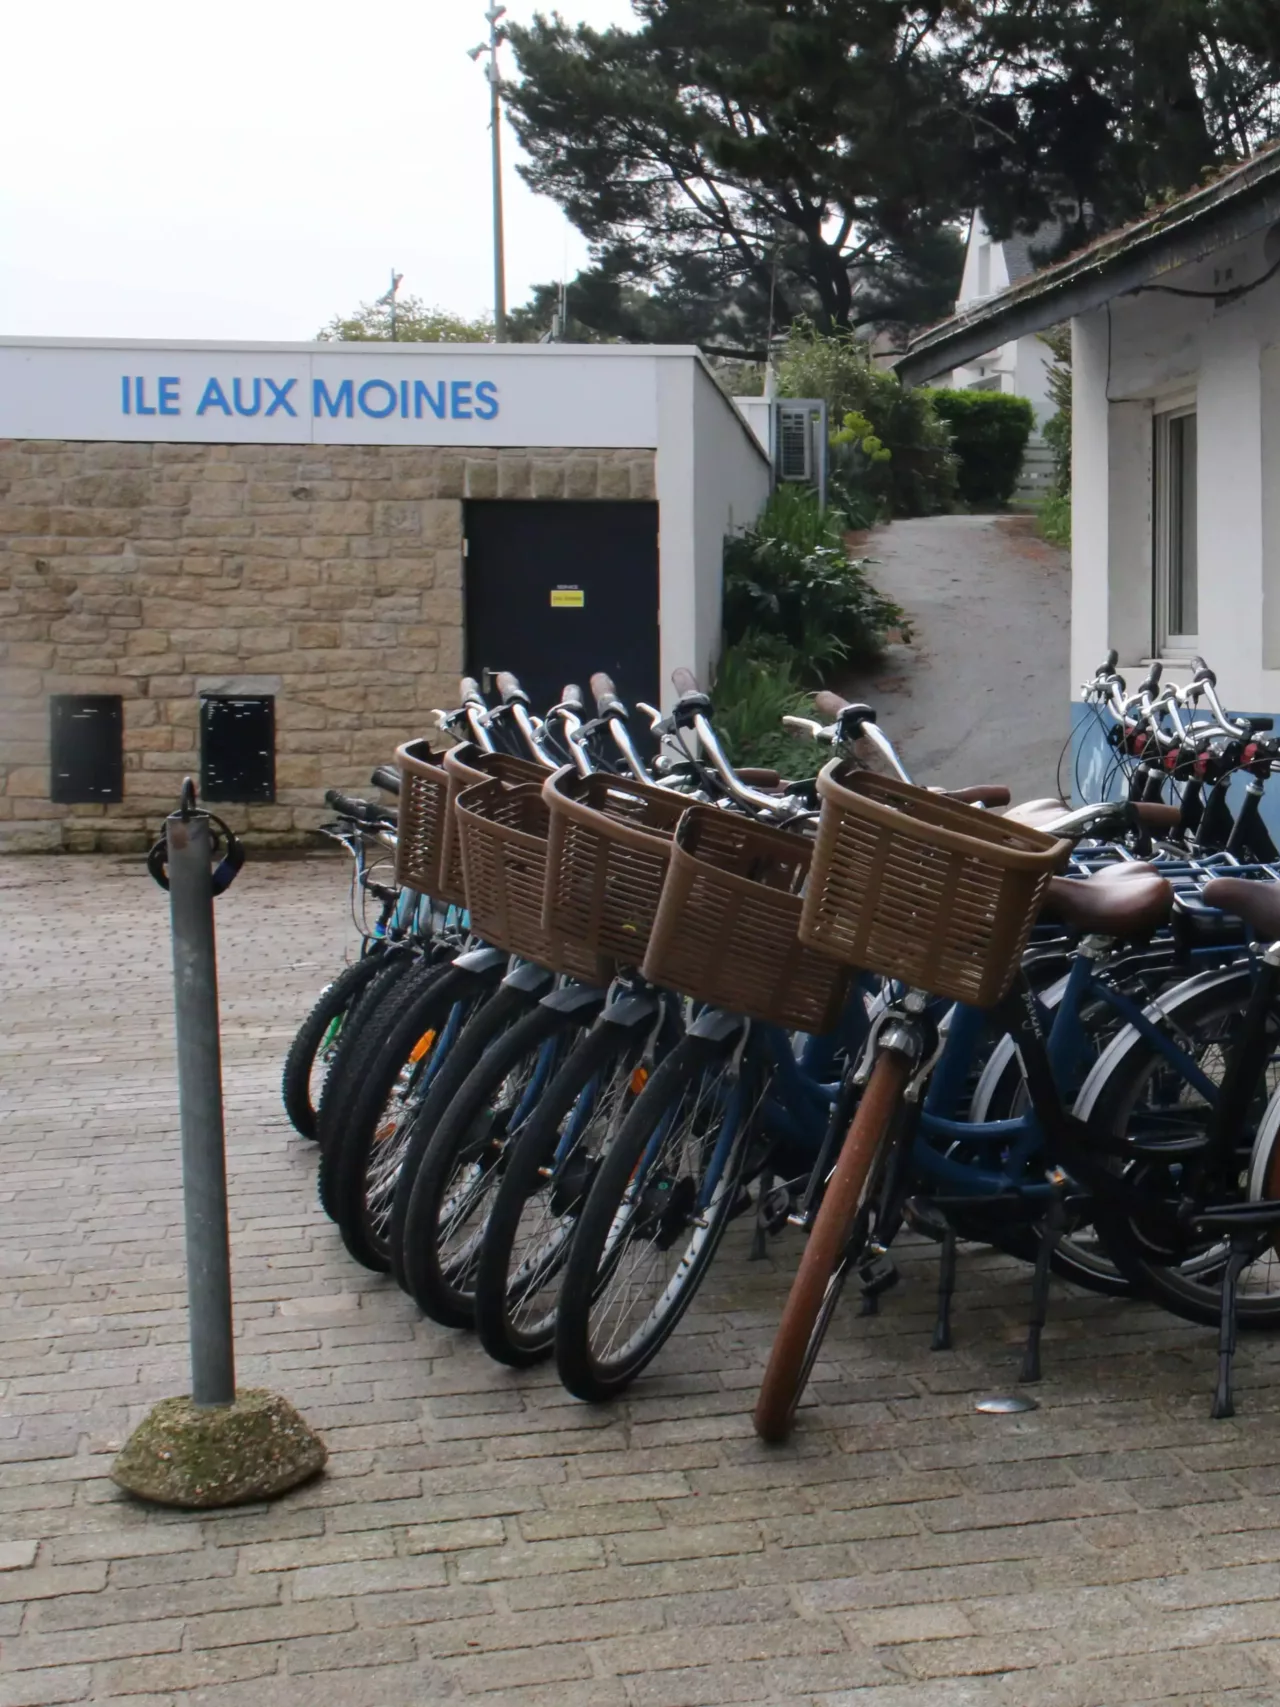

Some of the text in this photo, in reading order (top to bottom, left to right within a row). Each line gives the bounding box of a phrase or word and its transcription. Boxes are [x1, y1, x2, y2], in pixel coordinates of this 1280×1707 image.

[121, 376, 500, 420] ILE AUX MOINES
